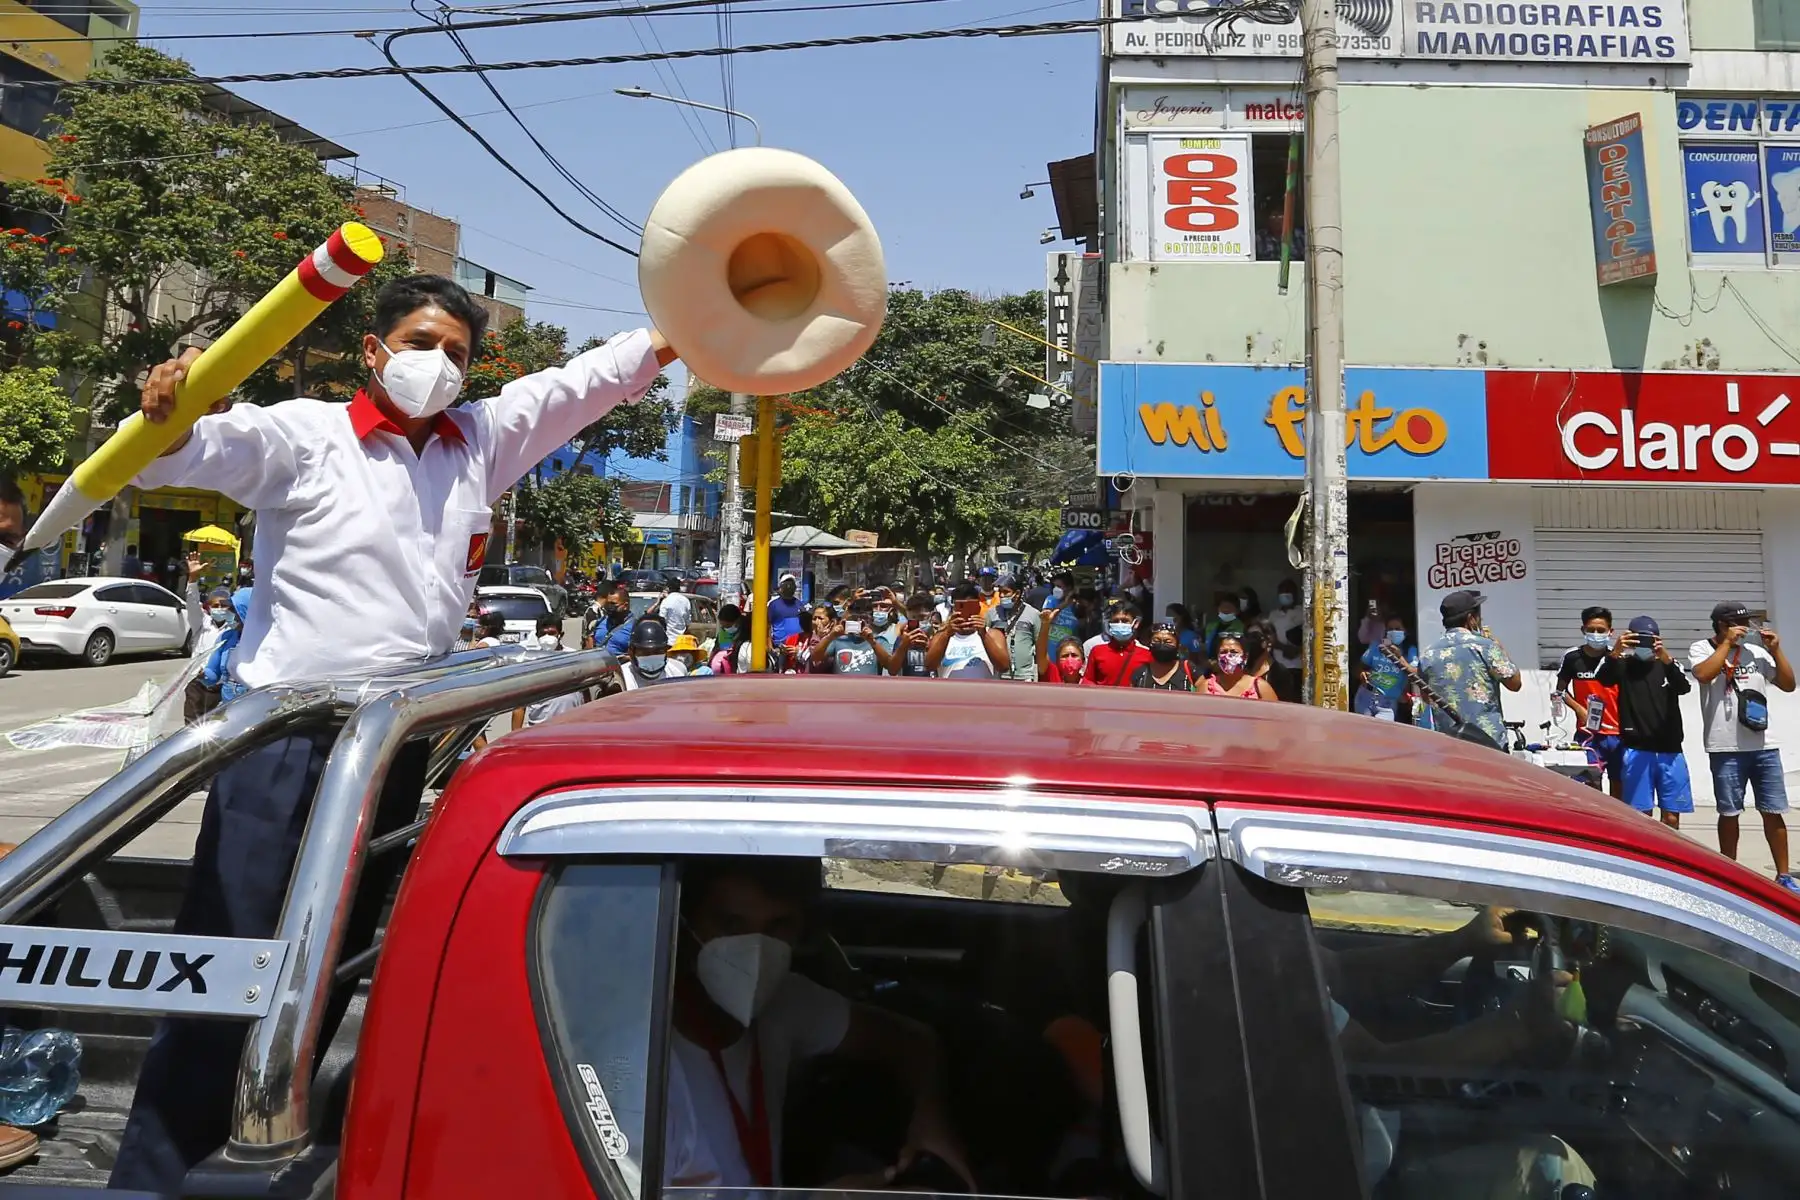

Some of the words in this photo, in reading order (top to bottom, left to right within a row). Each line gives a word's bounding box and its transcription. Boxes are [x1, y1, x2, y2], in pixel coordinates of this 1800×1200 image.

[1416, 2, 1662, 28] RADIOGRAFIAS
[1126, 33, 1148, 47] Av.
[1155, 33, 1203, 47] PEDRO
[1417, 31, 1675, 58] MAMOGRAFIAS
[1587, 117, 1638, 142] CONSULTORIO
[1180, 139, 1221, 149] COMPRO
[1689, 152, 1757, 162] CONSULTORIO
[1163, 153, 1239, 232] ORO
[1164, 241, 1241, 254] COTIZACIÓN
[1139, 391, 1228, 453] mi
[1265, 386, 1448, 458] fto
[1562, 408, 1760, 473] Claro
[1067, 512, 1101, 527] ORO
[1435, 539, 1521, 566] Prepago
[1428, 559, 1527, 590] Chévere
[0, 942, 215, 994] HILUX
